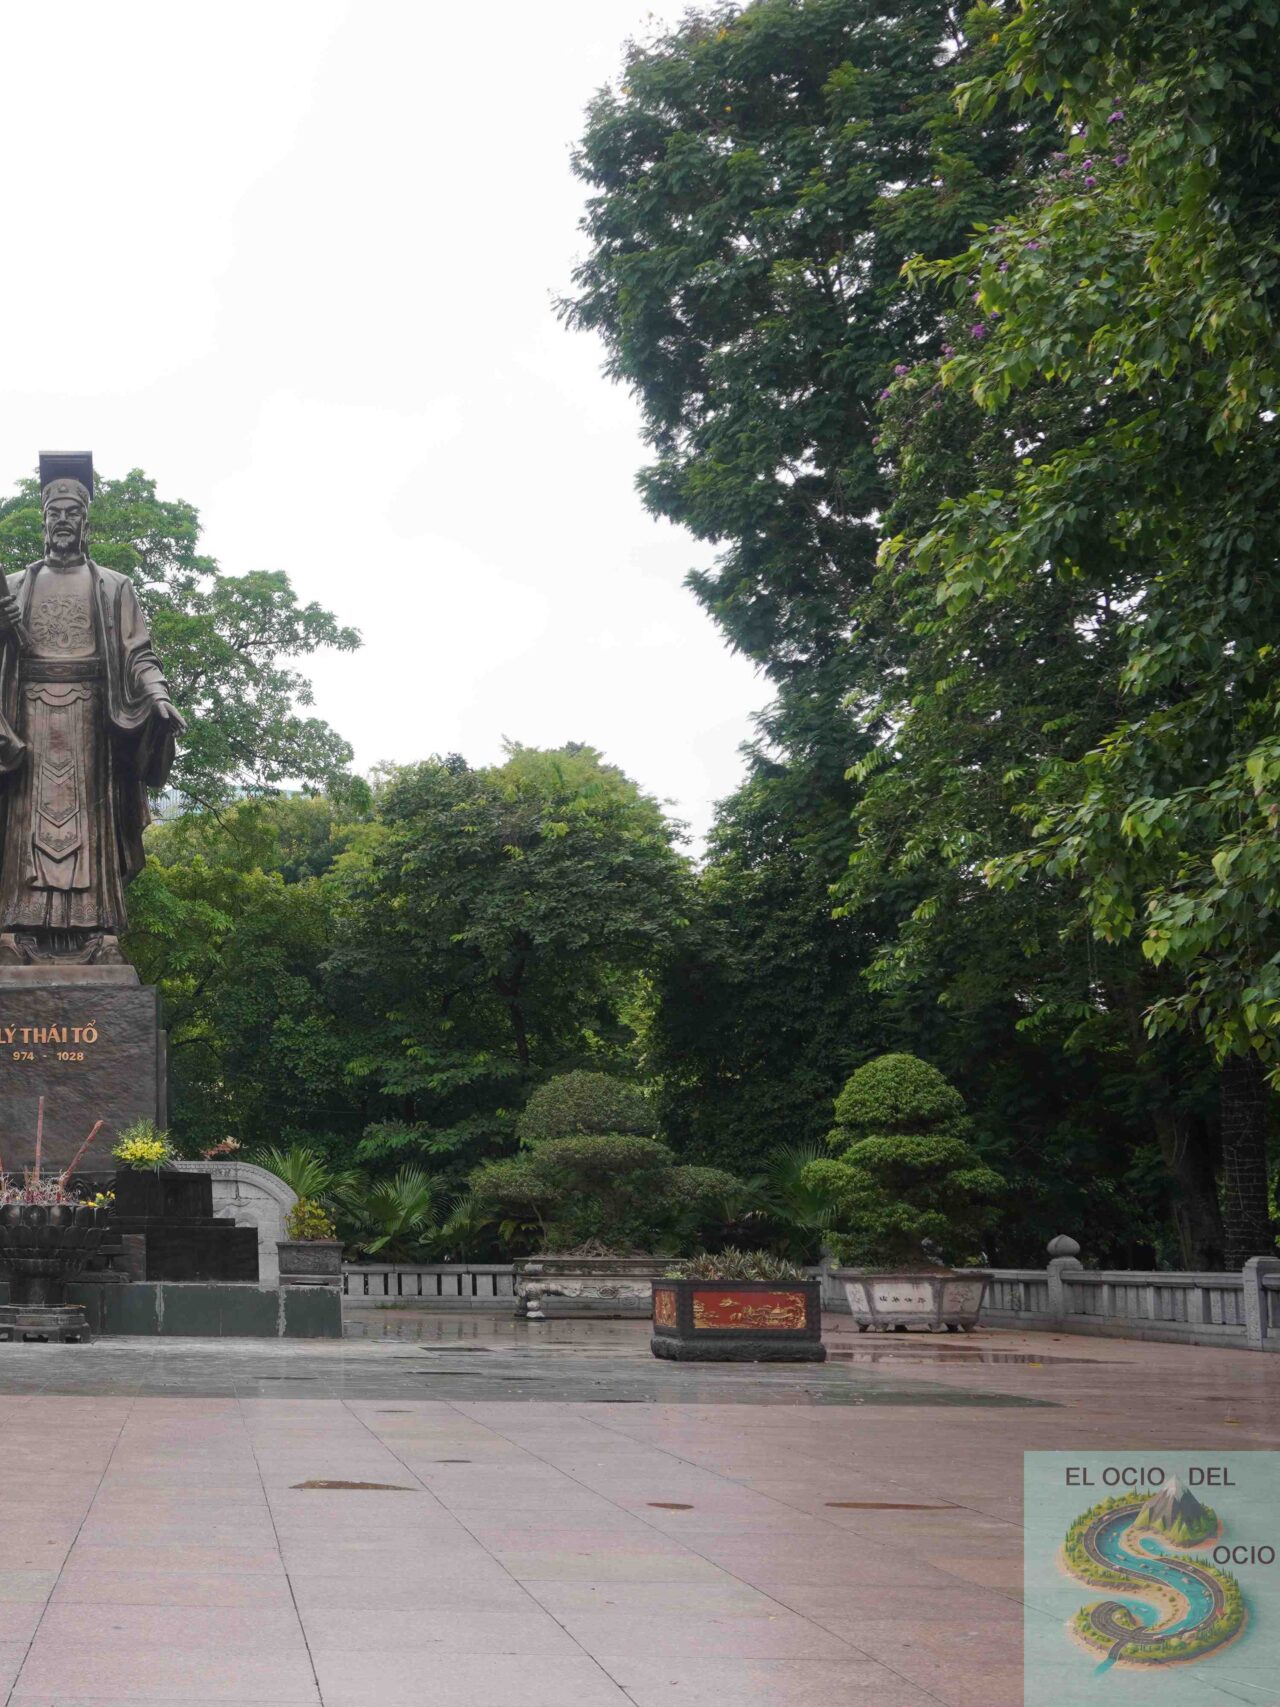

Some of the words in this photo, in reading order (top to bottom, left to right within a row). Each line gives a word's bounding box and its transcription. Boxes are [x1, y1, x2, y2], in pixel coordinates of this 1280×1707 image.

[20, 1023, 68, 1044] THÁI
[70, 1019, 98, 1044] TỔ
[12, 1051, 35, 1061] 974
[56, 1051, 85, 1061] 1028
